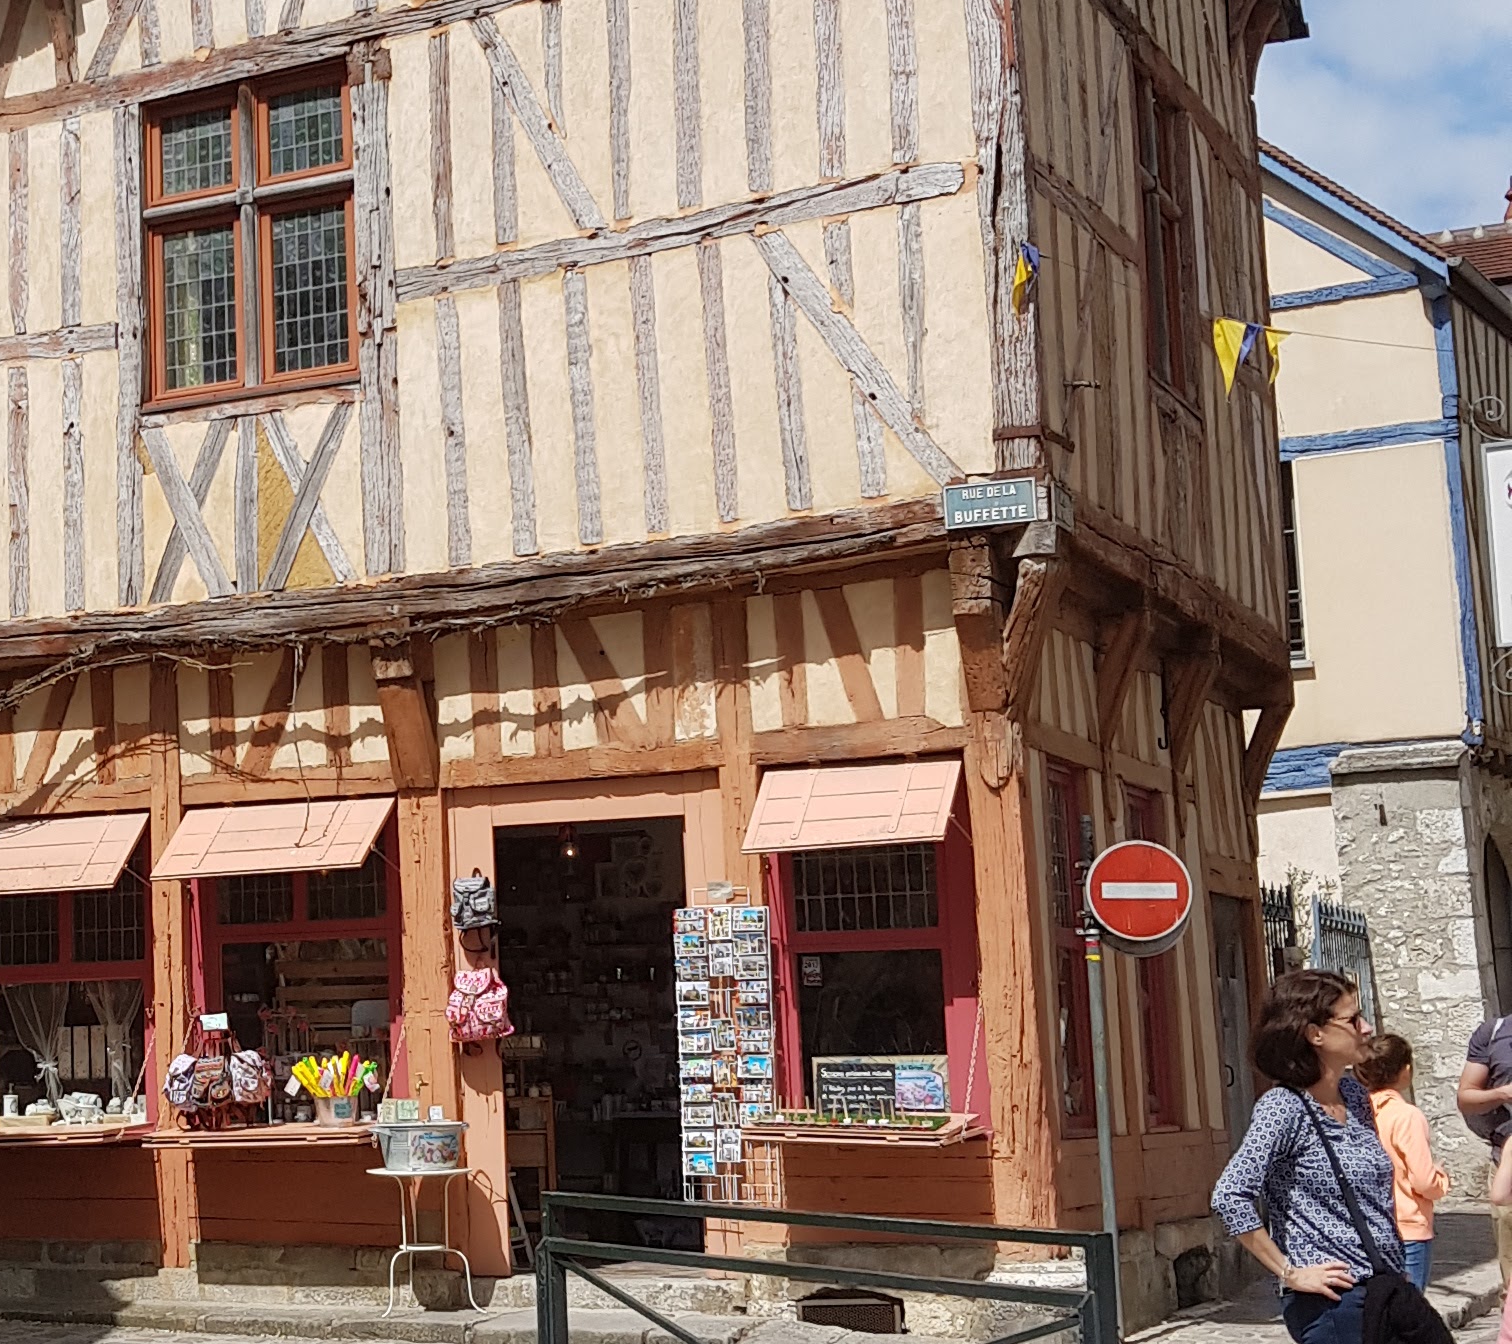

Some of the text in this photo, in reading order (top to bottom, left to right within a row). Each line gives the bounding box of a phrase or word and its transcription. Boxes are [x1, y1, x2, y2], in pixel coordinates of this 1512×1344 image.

[961, 484, 1017, 500] RUE DE LA
[954, 504, 1028, 524] BUFFETTE
